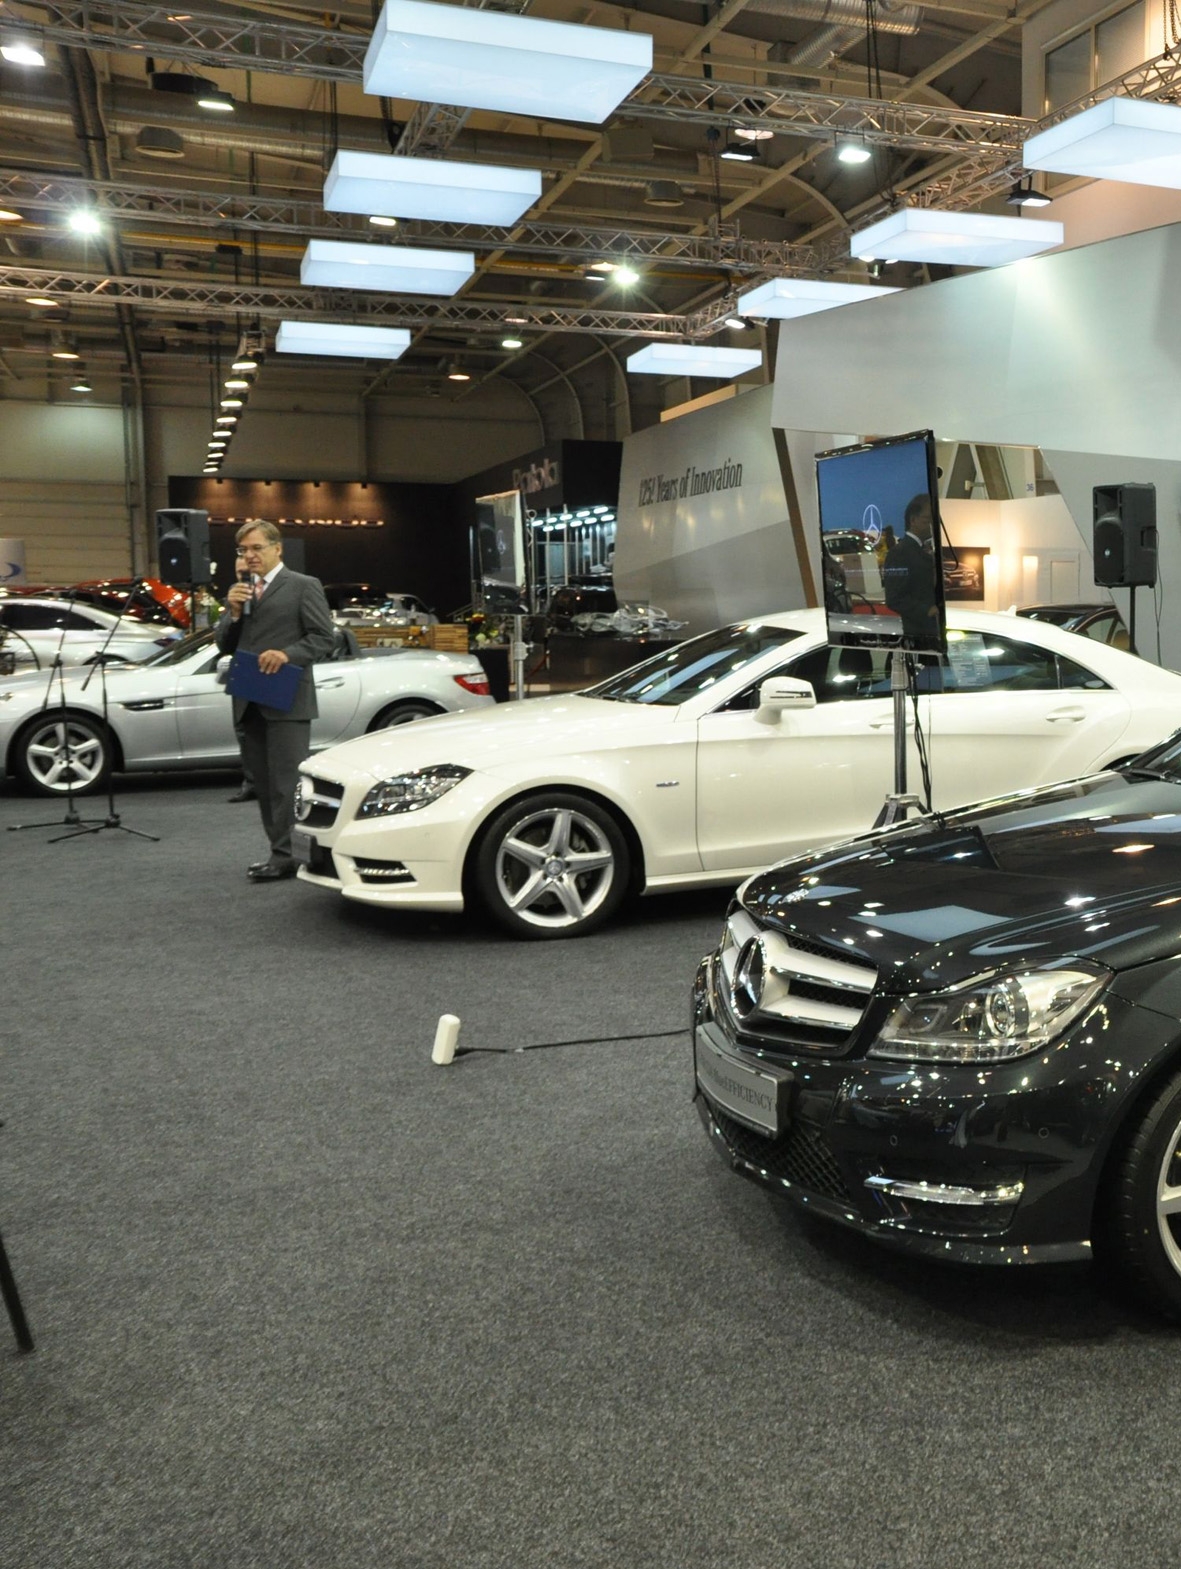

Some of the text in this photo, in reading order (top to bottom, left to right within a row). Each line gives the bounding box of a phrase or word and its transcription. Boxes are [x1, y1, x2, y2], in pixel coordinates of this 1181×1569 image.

[656, 474, 678, 503] Years
[679, 467, 690, 498] of
[690, 457, 743, 496] Innovation
